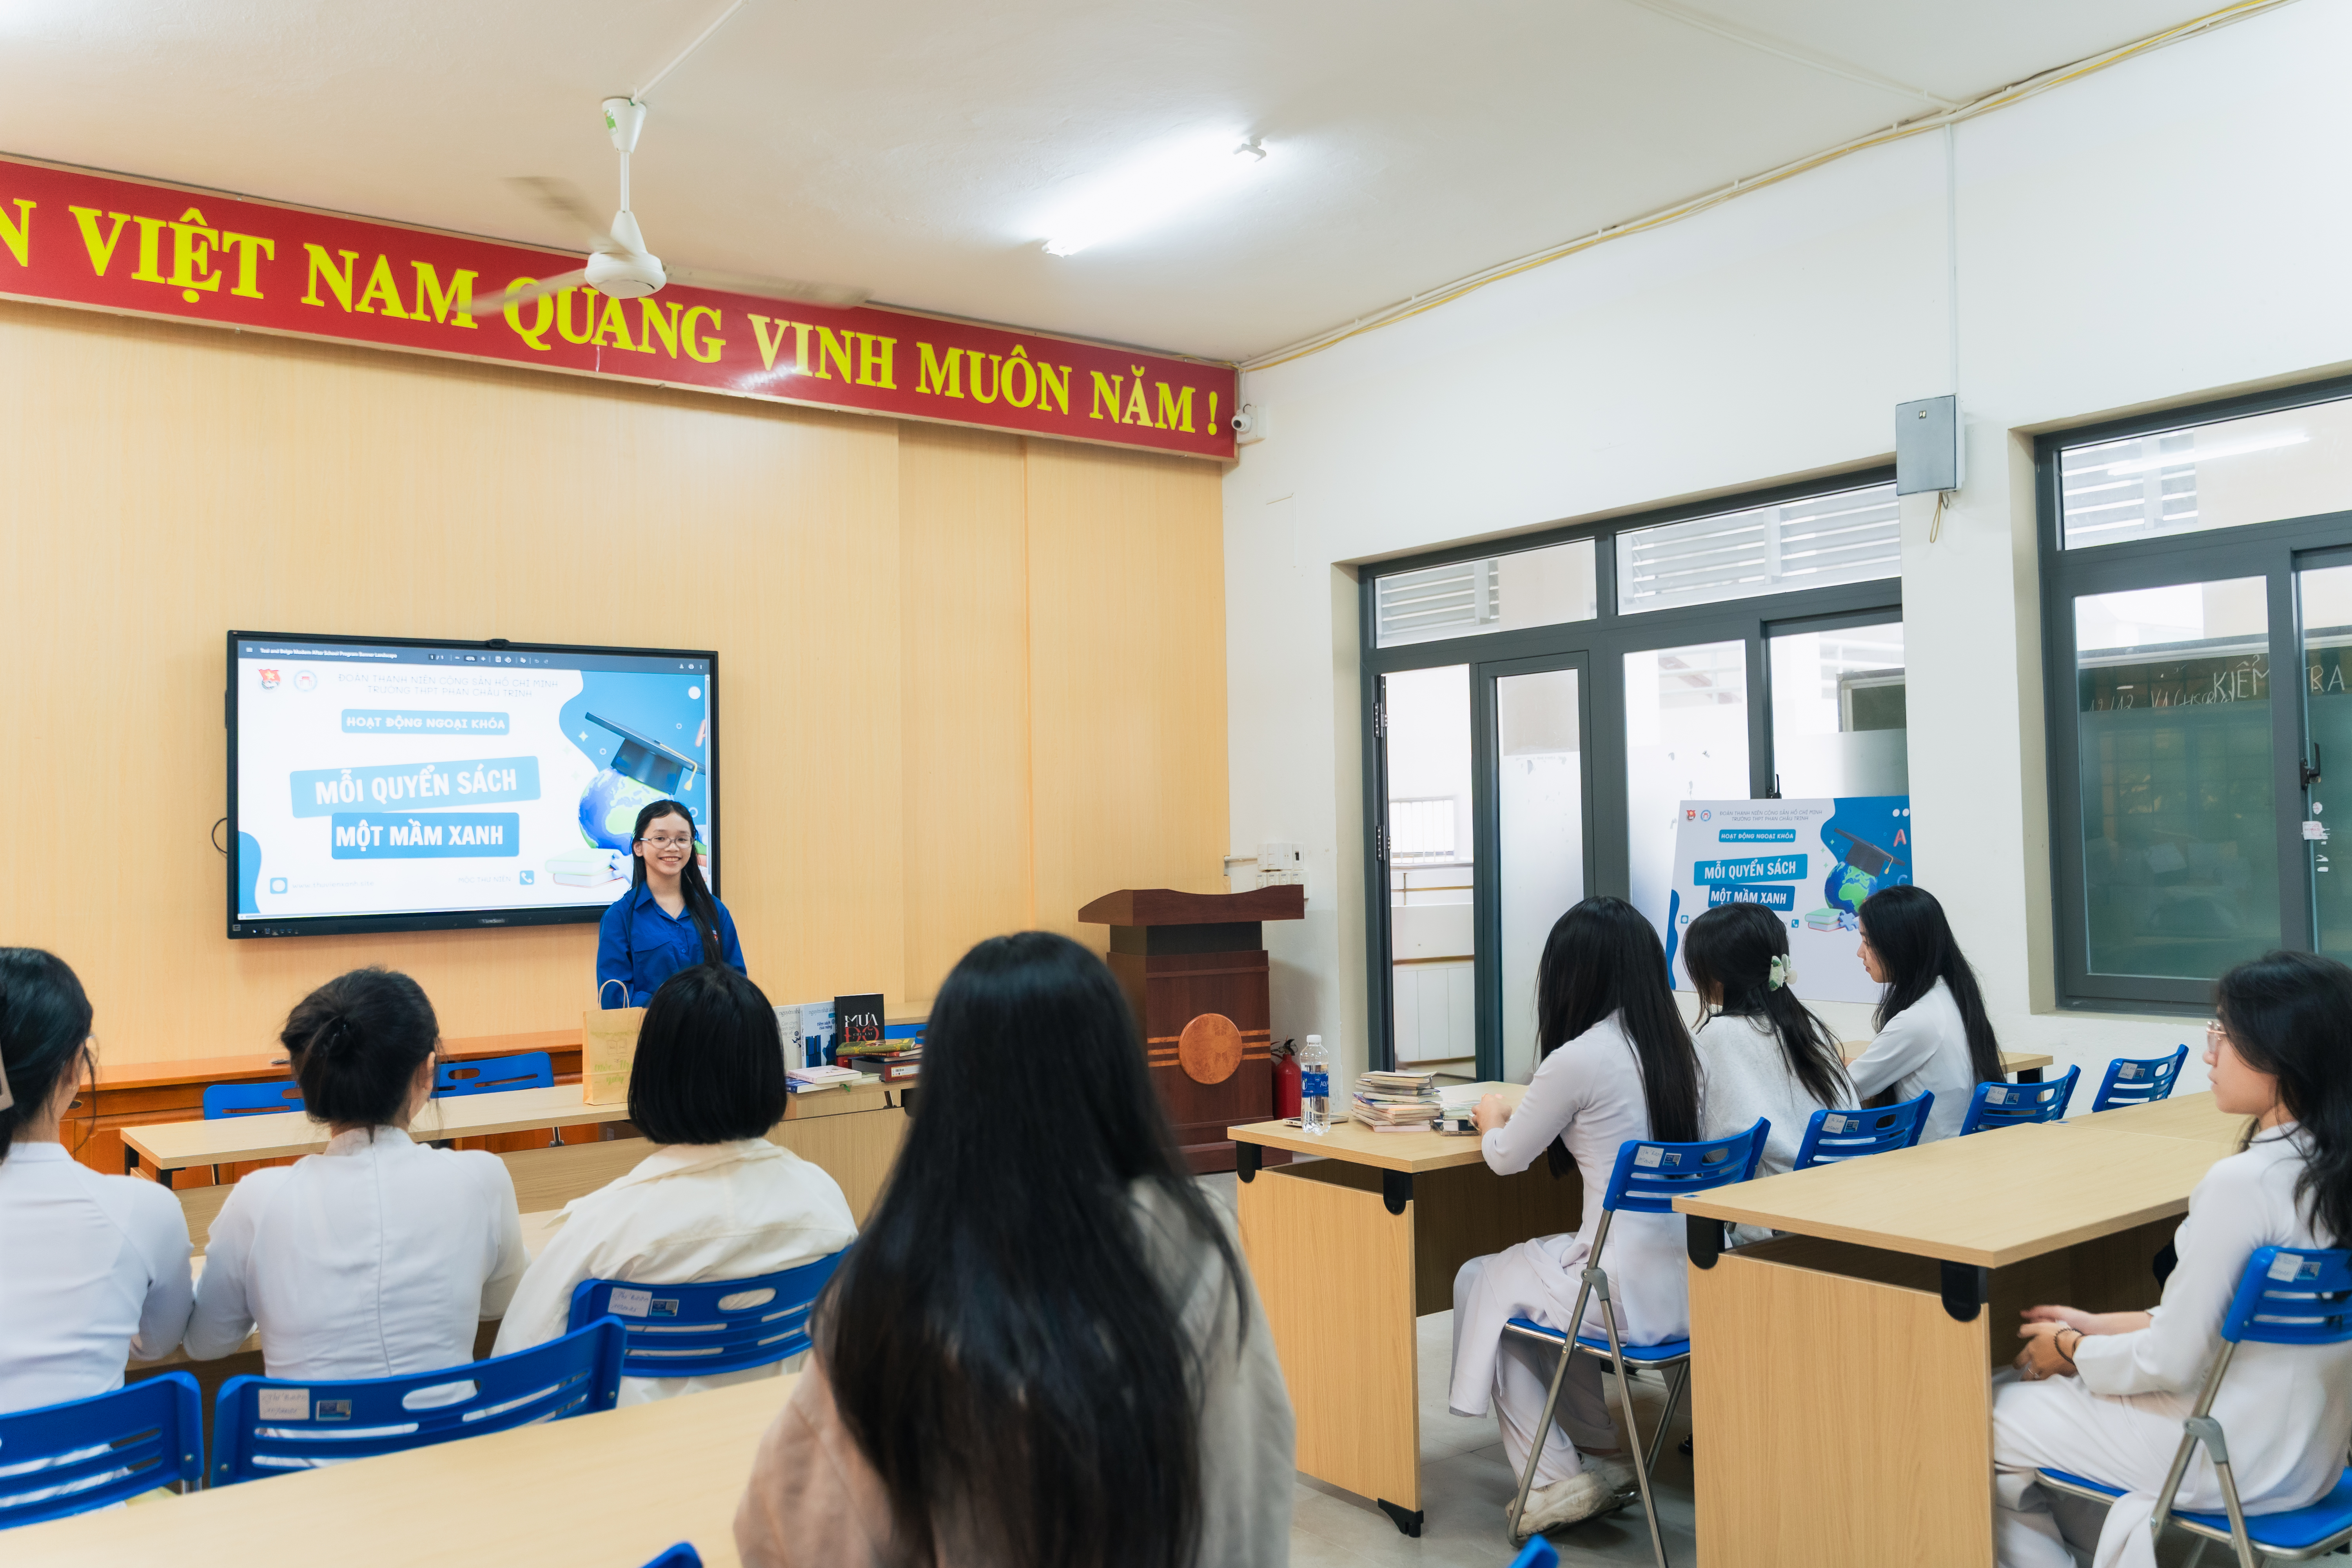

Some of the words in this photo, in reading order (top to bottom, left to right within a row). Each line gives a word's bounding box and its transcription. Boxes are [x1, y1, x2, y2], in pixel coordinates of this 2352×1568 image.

[69, 207, 275, 303] VIỆT
[301, 242, 479, 329] NAM
[503, 276, 725, 363] QUANG
[747, 313, 897, 390] VINH
[915, 343, 1072, 415] MUÔN
[1090, 364, 1196, 435] NĂM
[339, 673, 368, 682] ĐOÀN
[412, 675, 436, 684] NIÊN
[472, 675, 491, 686] SẢN
[513, 679, 529, 687] CHÍ
[2305, 664, 2345, 693] RA
[347, 717, 382, 729] HOẠT
[385, 715, 423, 730] ĐỘNG
[426, 718, 468, 730] NGOẠI
[471, 717, 505, 729] KHÓA
[316, 769, 364, 805] MỖI
[372, 764, 450, 805] QUYỂN
[457, 763, 517, 795] SÁCH
[336, 819, 383, 852] MỘT
[390, 818, 442, 846] MẦM
[448, 826, 503, 845] XANH
[1704, 861, 1725, 879] MỖI
[1729, 859, 1764, 880] QUYỂN
[1767, 858, 1796, 875] SÁCH
[1711, 887, 1731, 904] MỘT
[1734, 888, 1758, 903] MẦM
[1760, 893, 1786, 904] XANH
[845, 1012, 878, 1027] MƯA
